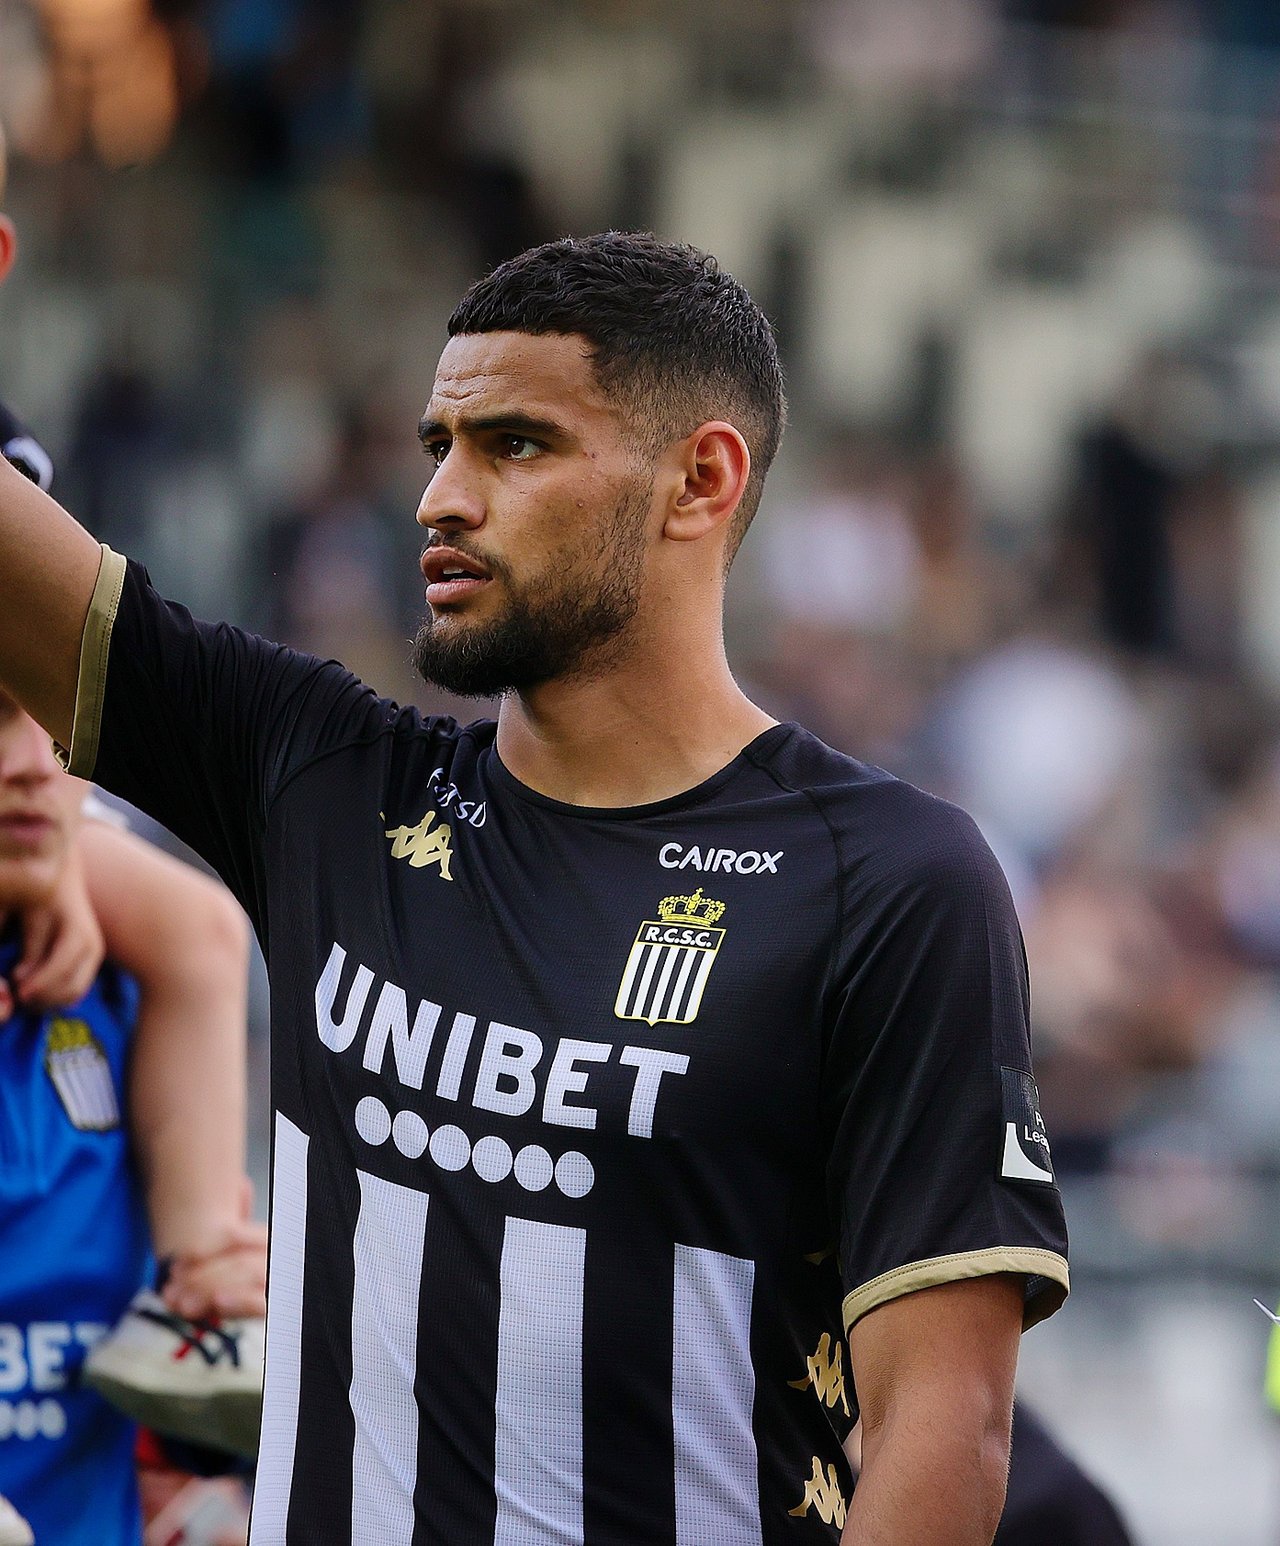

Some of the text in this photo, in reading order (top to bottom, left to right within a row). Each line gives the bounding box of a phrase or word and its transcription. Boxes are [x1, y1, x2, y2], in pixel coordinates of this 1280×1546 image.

[658, 842, 785, 875] CAIROX
[644, 926, 712, 948] R.C.S.C.
[315, 941, 691, 1139] UNIBET
